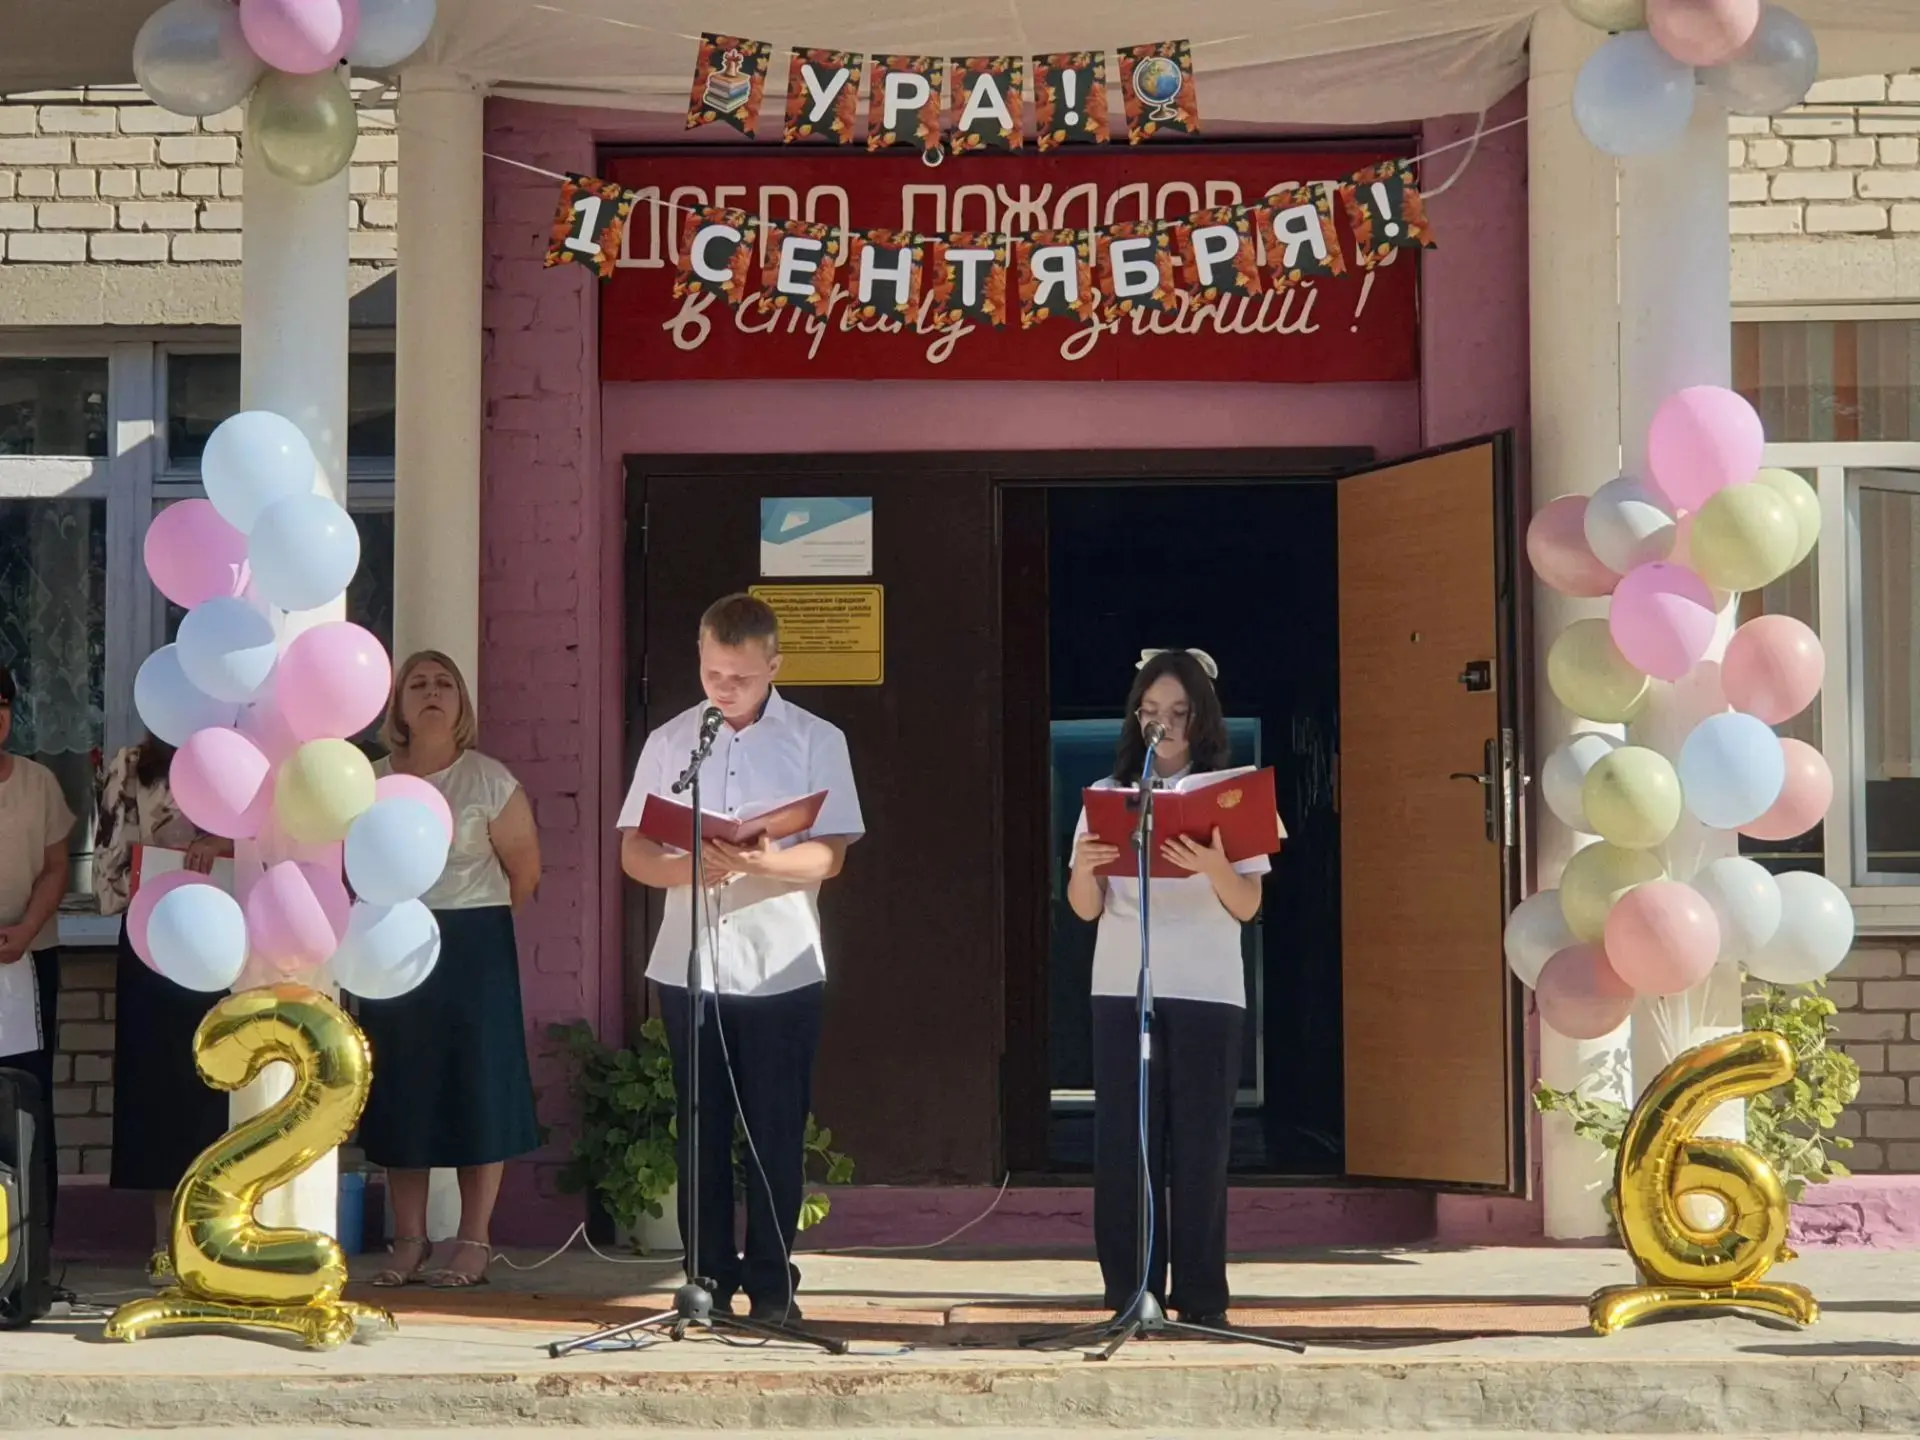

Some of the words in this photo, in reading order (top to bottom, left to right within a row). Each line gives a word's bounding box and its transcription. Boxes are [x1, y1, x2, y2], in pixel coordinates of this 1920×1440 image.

[800, 63, 1080, 132] УРА!
[564, 194, 602, 256] 1
[690, 182, 1400, 307] СЕНТЯБРЯ!
[616, 184, 849, 268] ДОРО
